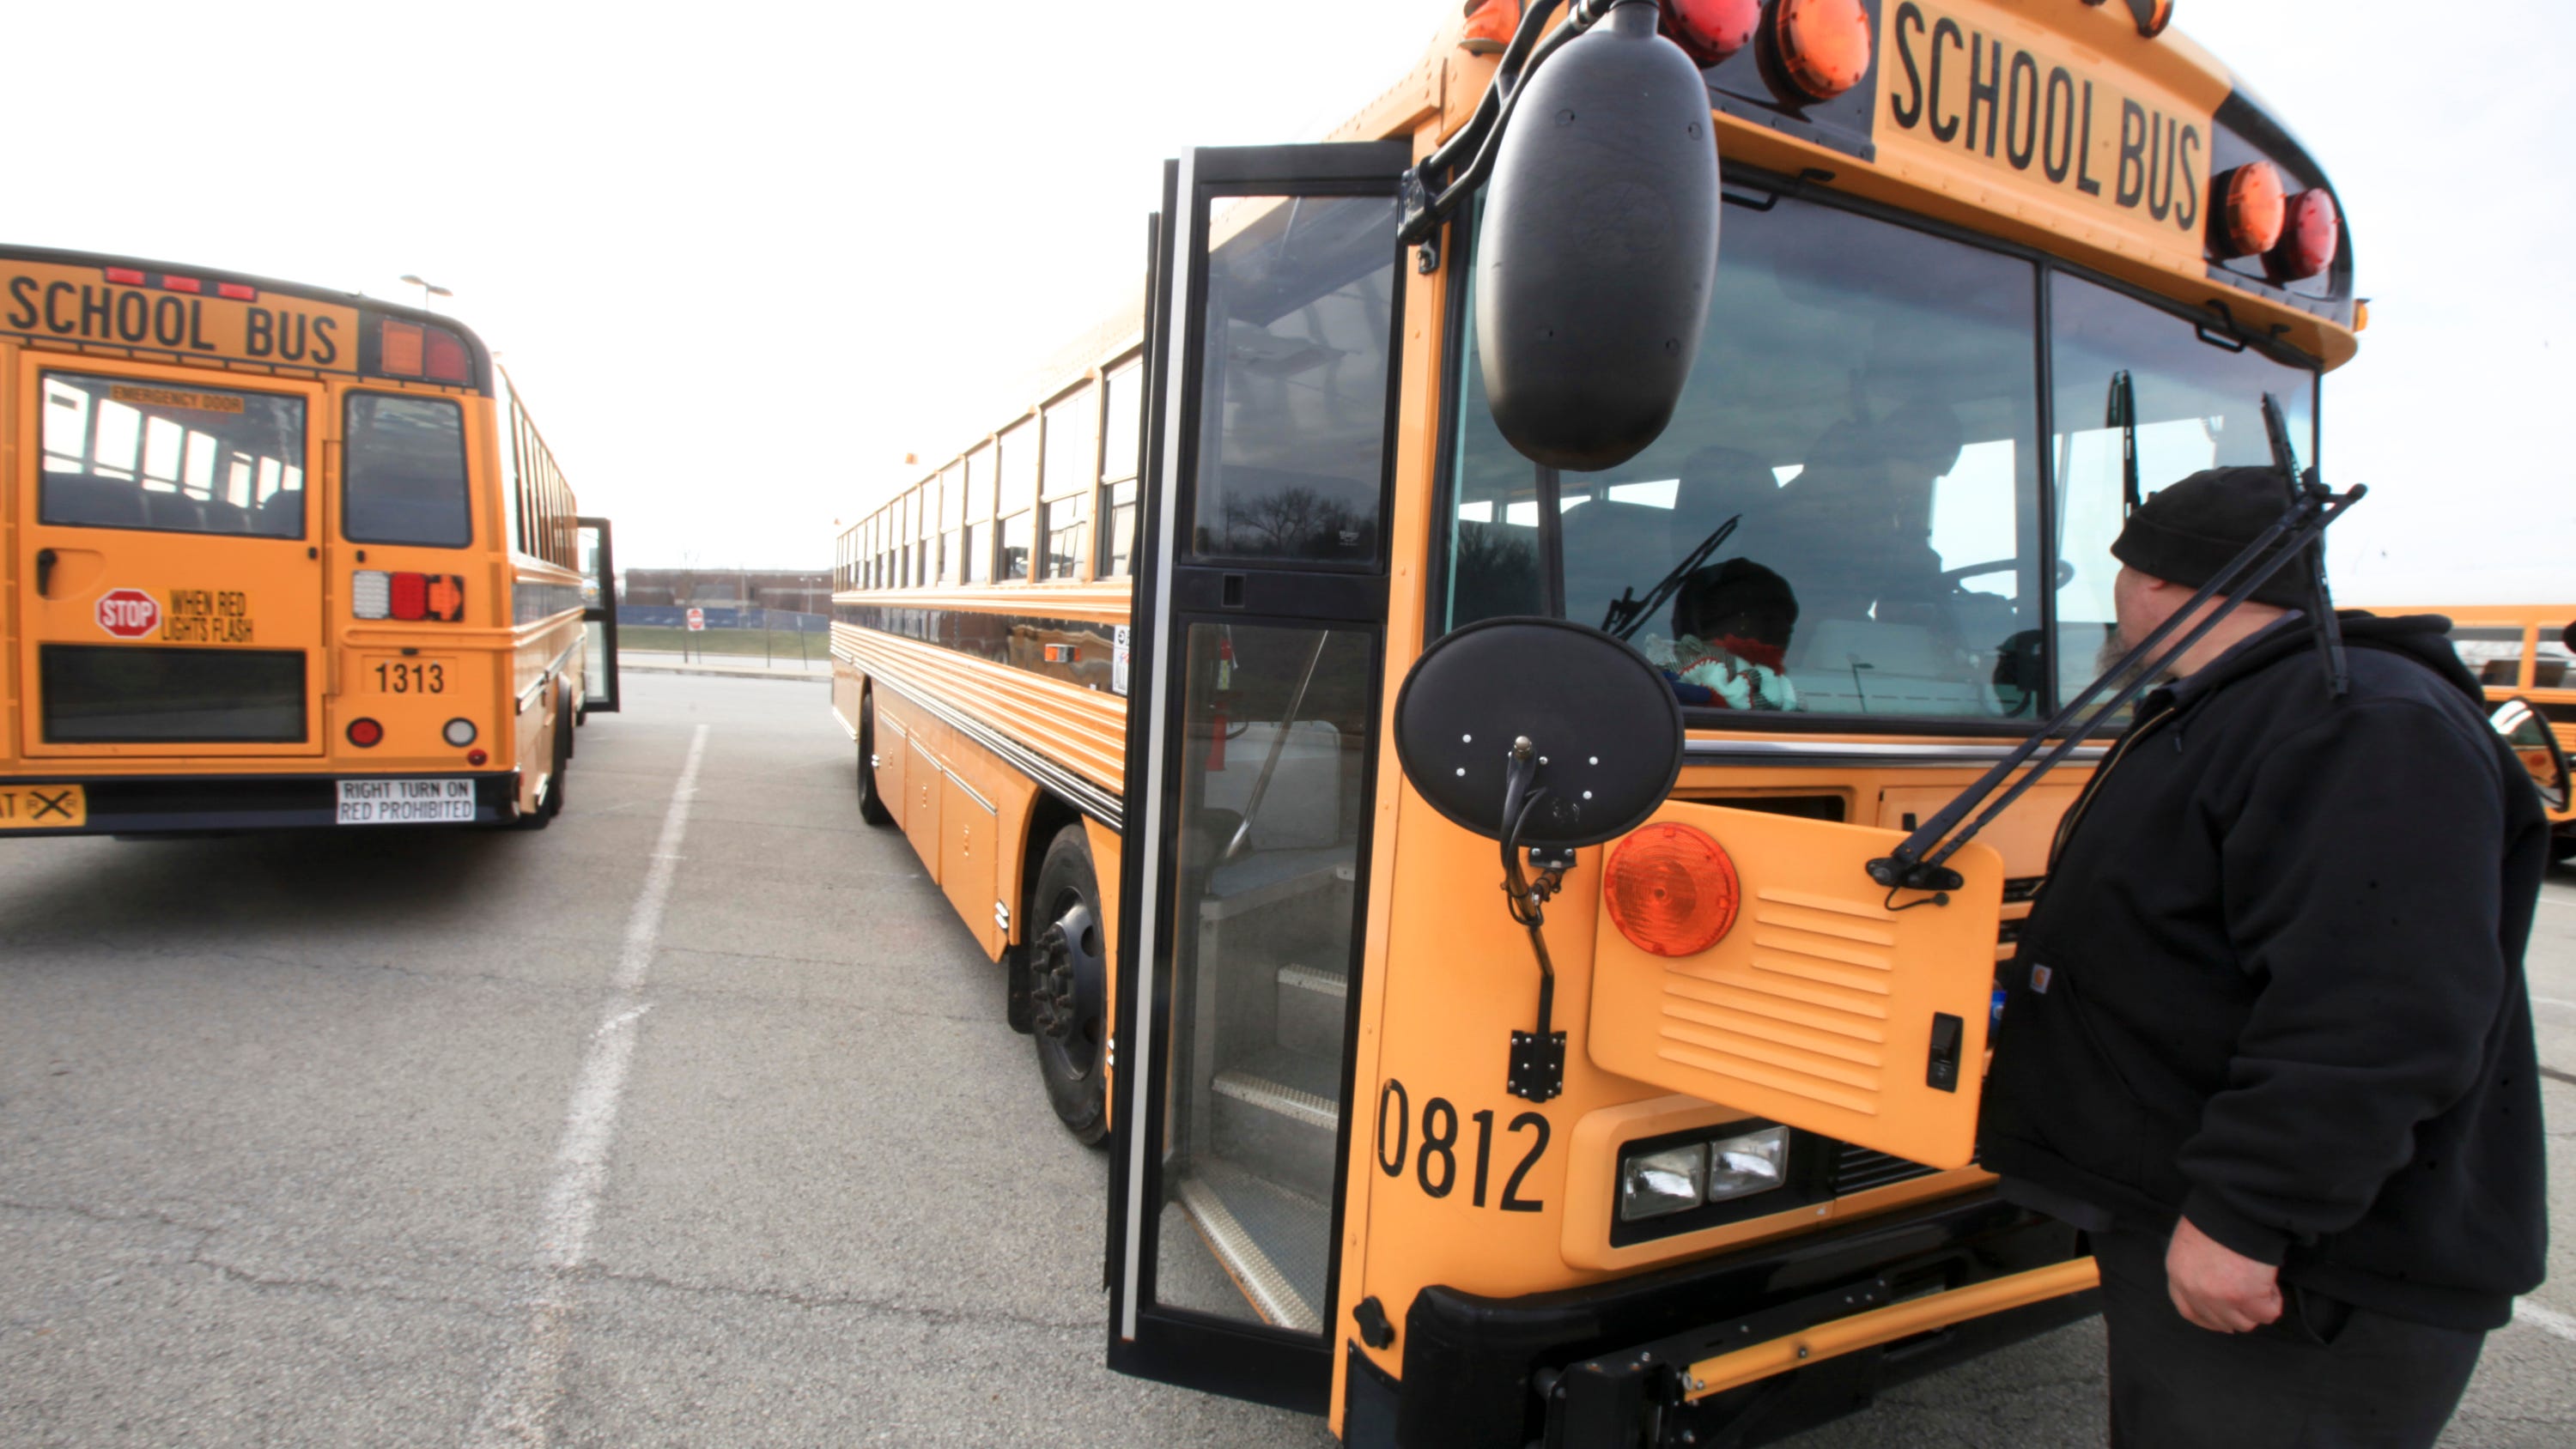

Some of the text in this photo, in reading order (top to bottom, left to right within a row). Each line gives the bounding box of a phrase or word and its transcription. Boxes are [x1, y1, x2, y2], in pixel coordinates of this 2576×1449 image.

[1891, 2, 2202, 232] SCHOOL BUS
[8, 276, 337, 365] SCHOOL BUS
[102, 599, 154, 627] STOP
[170, 590, 246, 616] WHEN RED
[161, 615, 253, 642] LIGHTS FLASH
[375, 664, 444, 694] 1313
[344, 781, 469, 799] RIGHT TURN ON
[341, 800, 472, 821] RED PROHIBITED
[1377, 1078, 1551, 1212] 0812
